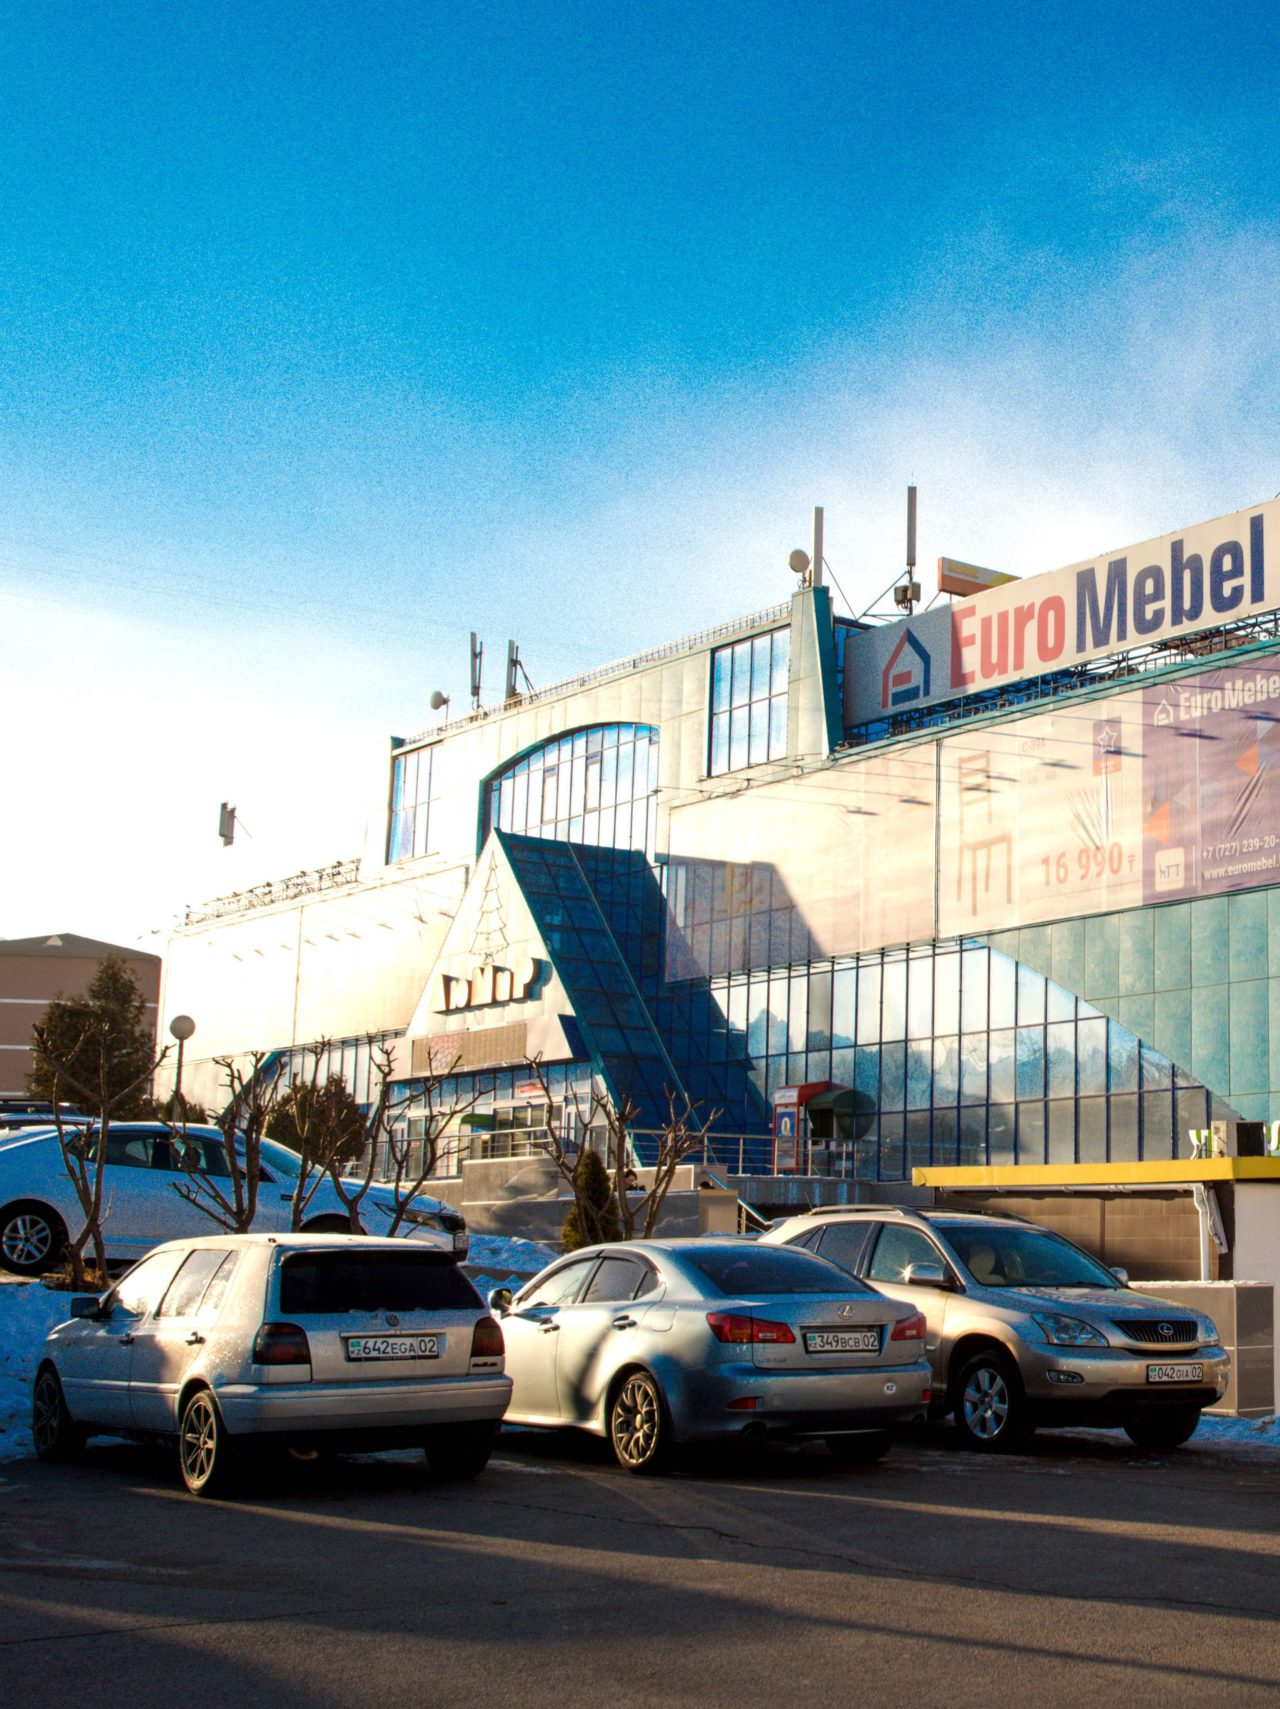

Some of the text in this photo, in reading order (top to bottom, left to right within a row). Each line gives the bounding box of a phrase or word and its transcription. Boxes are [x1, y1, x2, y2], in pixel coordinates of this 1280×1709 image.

[1202, 846, 1213, 860] +7
[1215, 841, 1240, 861] (727)
[1041, 854, 1068, 887] 16
[1077, 841, 1123, 881] 990
[419, 1338, 437, 1354] 02
[863, 1333, 878, 1349] 02
[1191, 1367, 1202, 1379] 02
